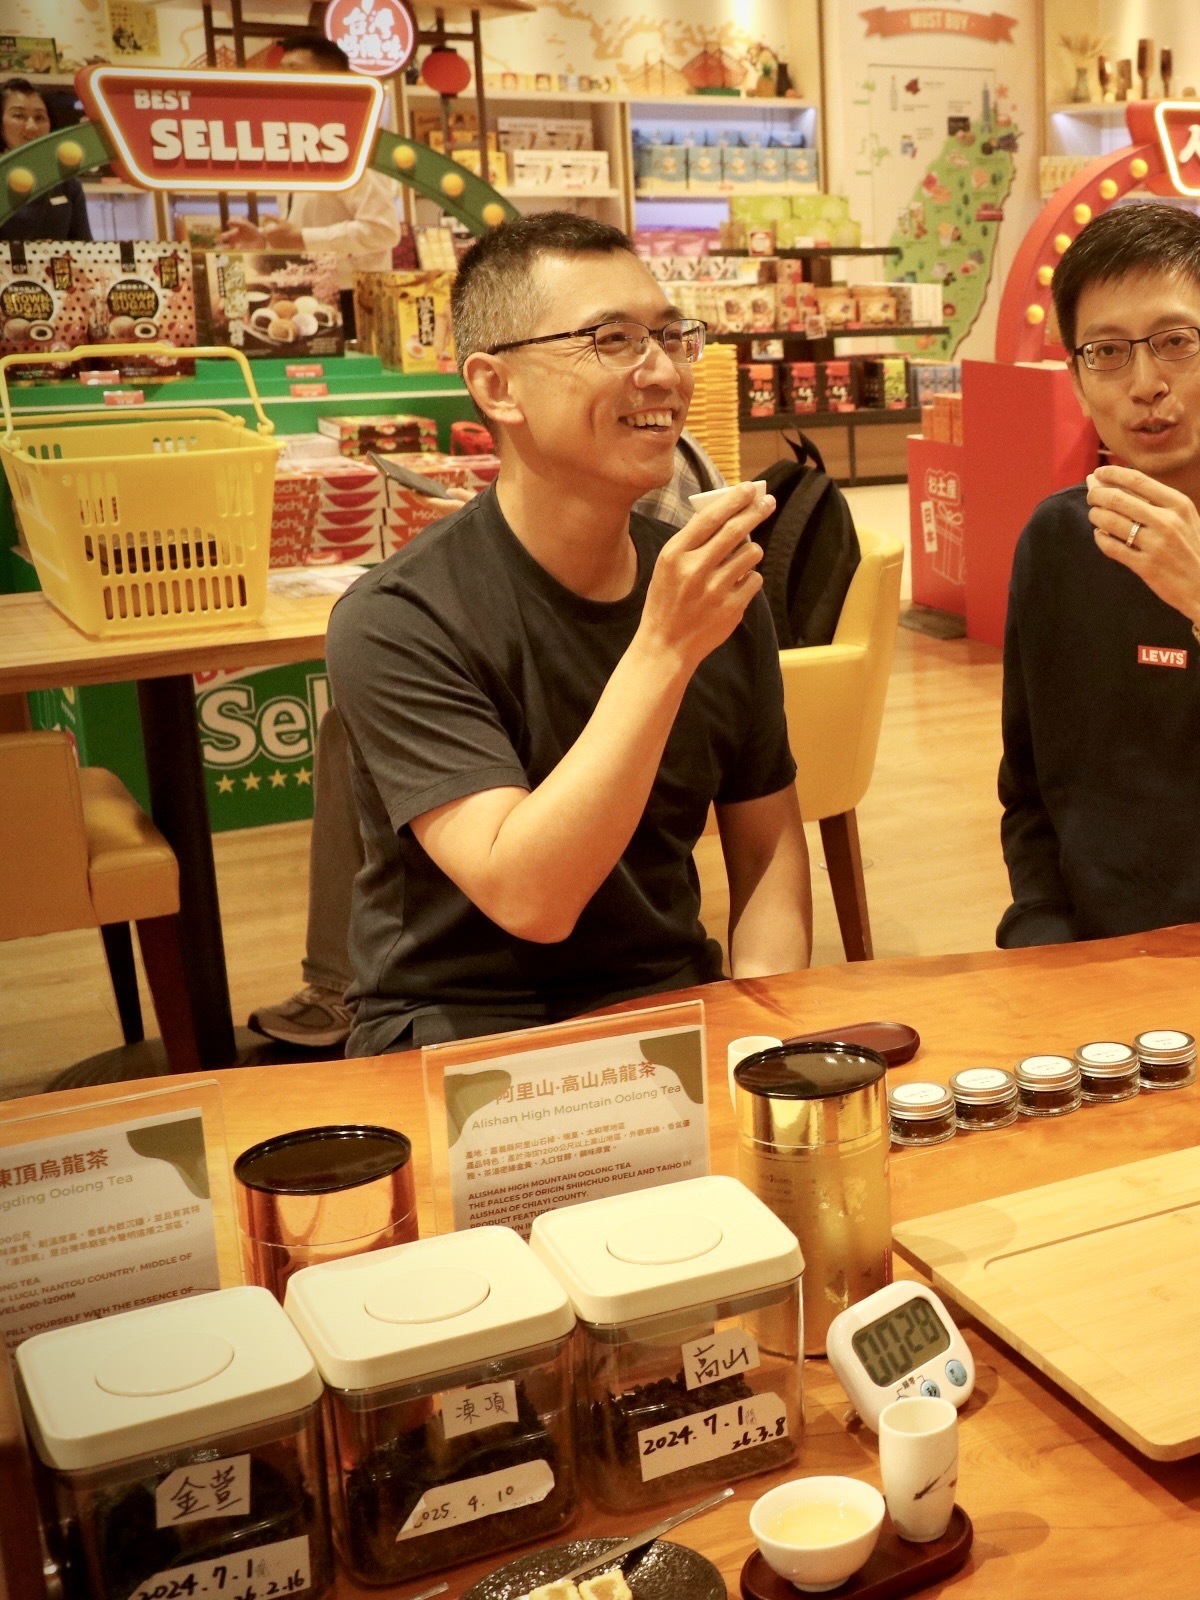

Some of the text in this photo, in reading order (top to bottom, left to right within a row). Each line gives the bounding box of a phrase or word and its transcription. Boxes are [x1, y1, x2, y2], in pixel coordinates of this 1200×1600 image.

[909, 11, 943, 30] MUST
[133, 89, 191, 110] BEST
[150, 119, 349, 163] SELLERS
[3, 293, 49, 304] BROWN
[6, 301, 48, 314] SUGAR
[110, 291, 156, 301] BROWN
[112, 299, 155, 311] SUGAR
[1142, 648, 1184, 665] LEVI'S
[471, 1084, 681, 1130] Alishan High Mountain Oolong Tea
[50, 1179, 104, 1199] Oolong
[107, 1173, 133, 1187] Tea
[469, 1161, 631, 1200] ALISHAN HIGH MOUNTAIN OOLONG TEA
[469, 1159, 692, 1210] THE PALCES OF ORIGIN SHIHCHUO RUELI AND TAIHO IN
[469, 1207, 507, 1221] ALISHAN
[508, 1204, 520, 1212] OF
[522, 1197, 551, 1209] CHIAYI
[20, 1277, 41, 1288] TEA
[42, 1278, 86, 1294] NANTOU
[140, 1256, 178, 1272] MIDDLE
[179, 1252, 193, 1262] OF
[6, 1286, 194, 1338] FILL YOURSELF WITH THE ESSENCE OF
[693, 1344, 750, 1384] 高山
